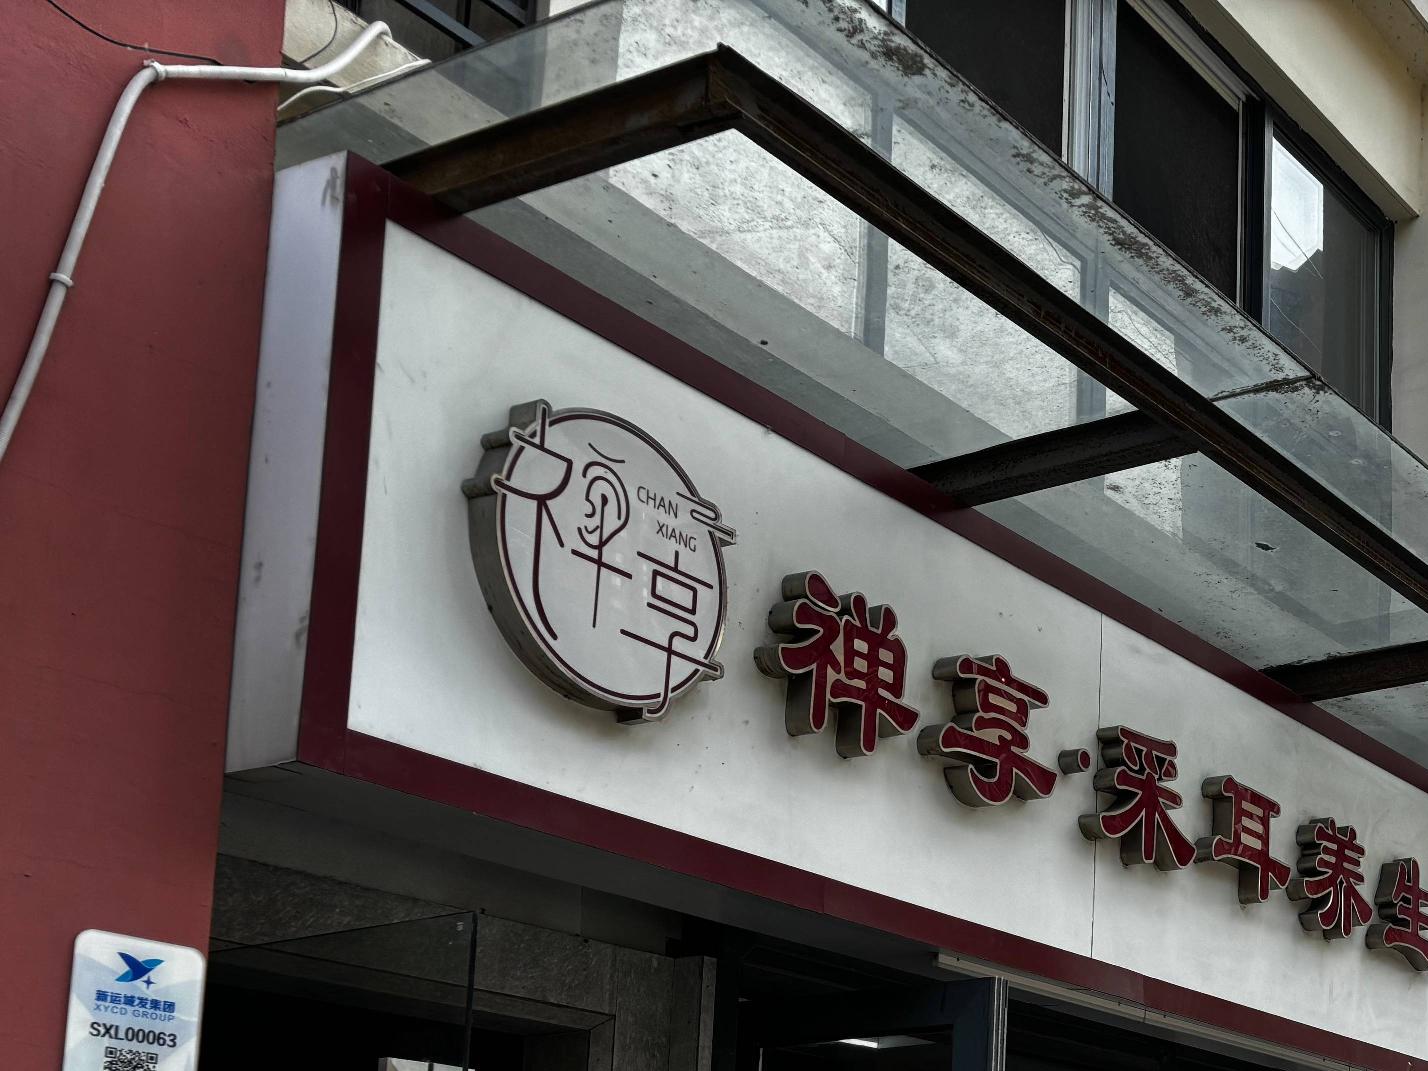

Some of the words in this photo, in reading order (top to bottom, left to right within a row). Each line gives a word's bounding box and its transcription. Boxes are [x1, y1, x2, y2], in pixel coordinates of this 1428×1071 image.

[636, 484, 679, 519] CHAN
[655, 520, 698, 553] XIANG
[93, 1003, 128, 1016] XYCD
[131, 1009, 176, 1022] GROUP
[89, 1021, 178, 1048] SXL00063
